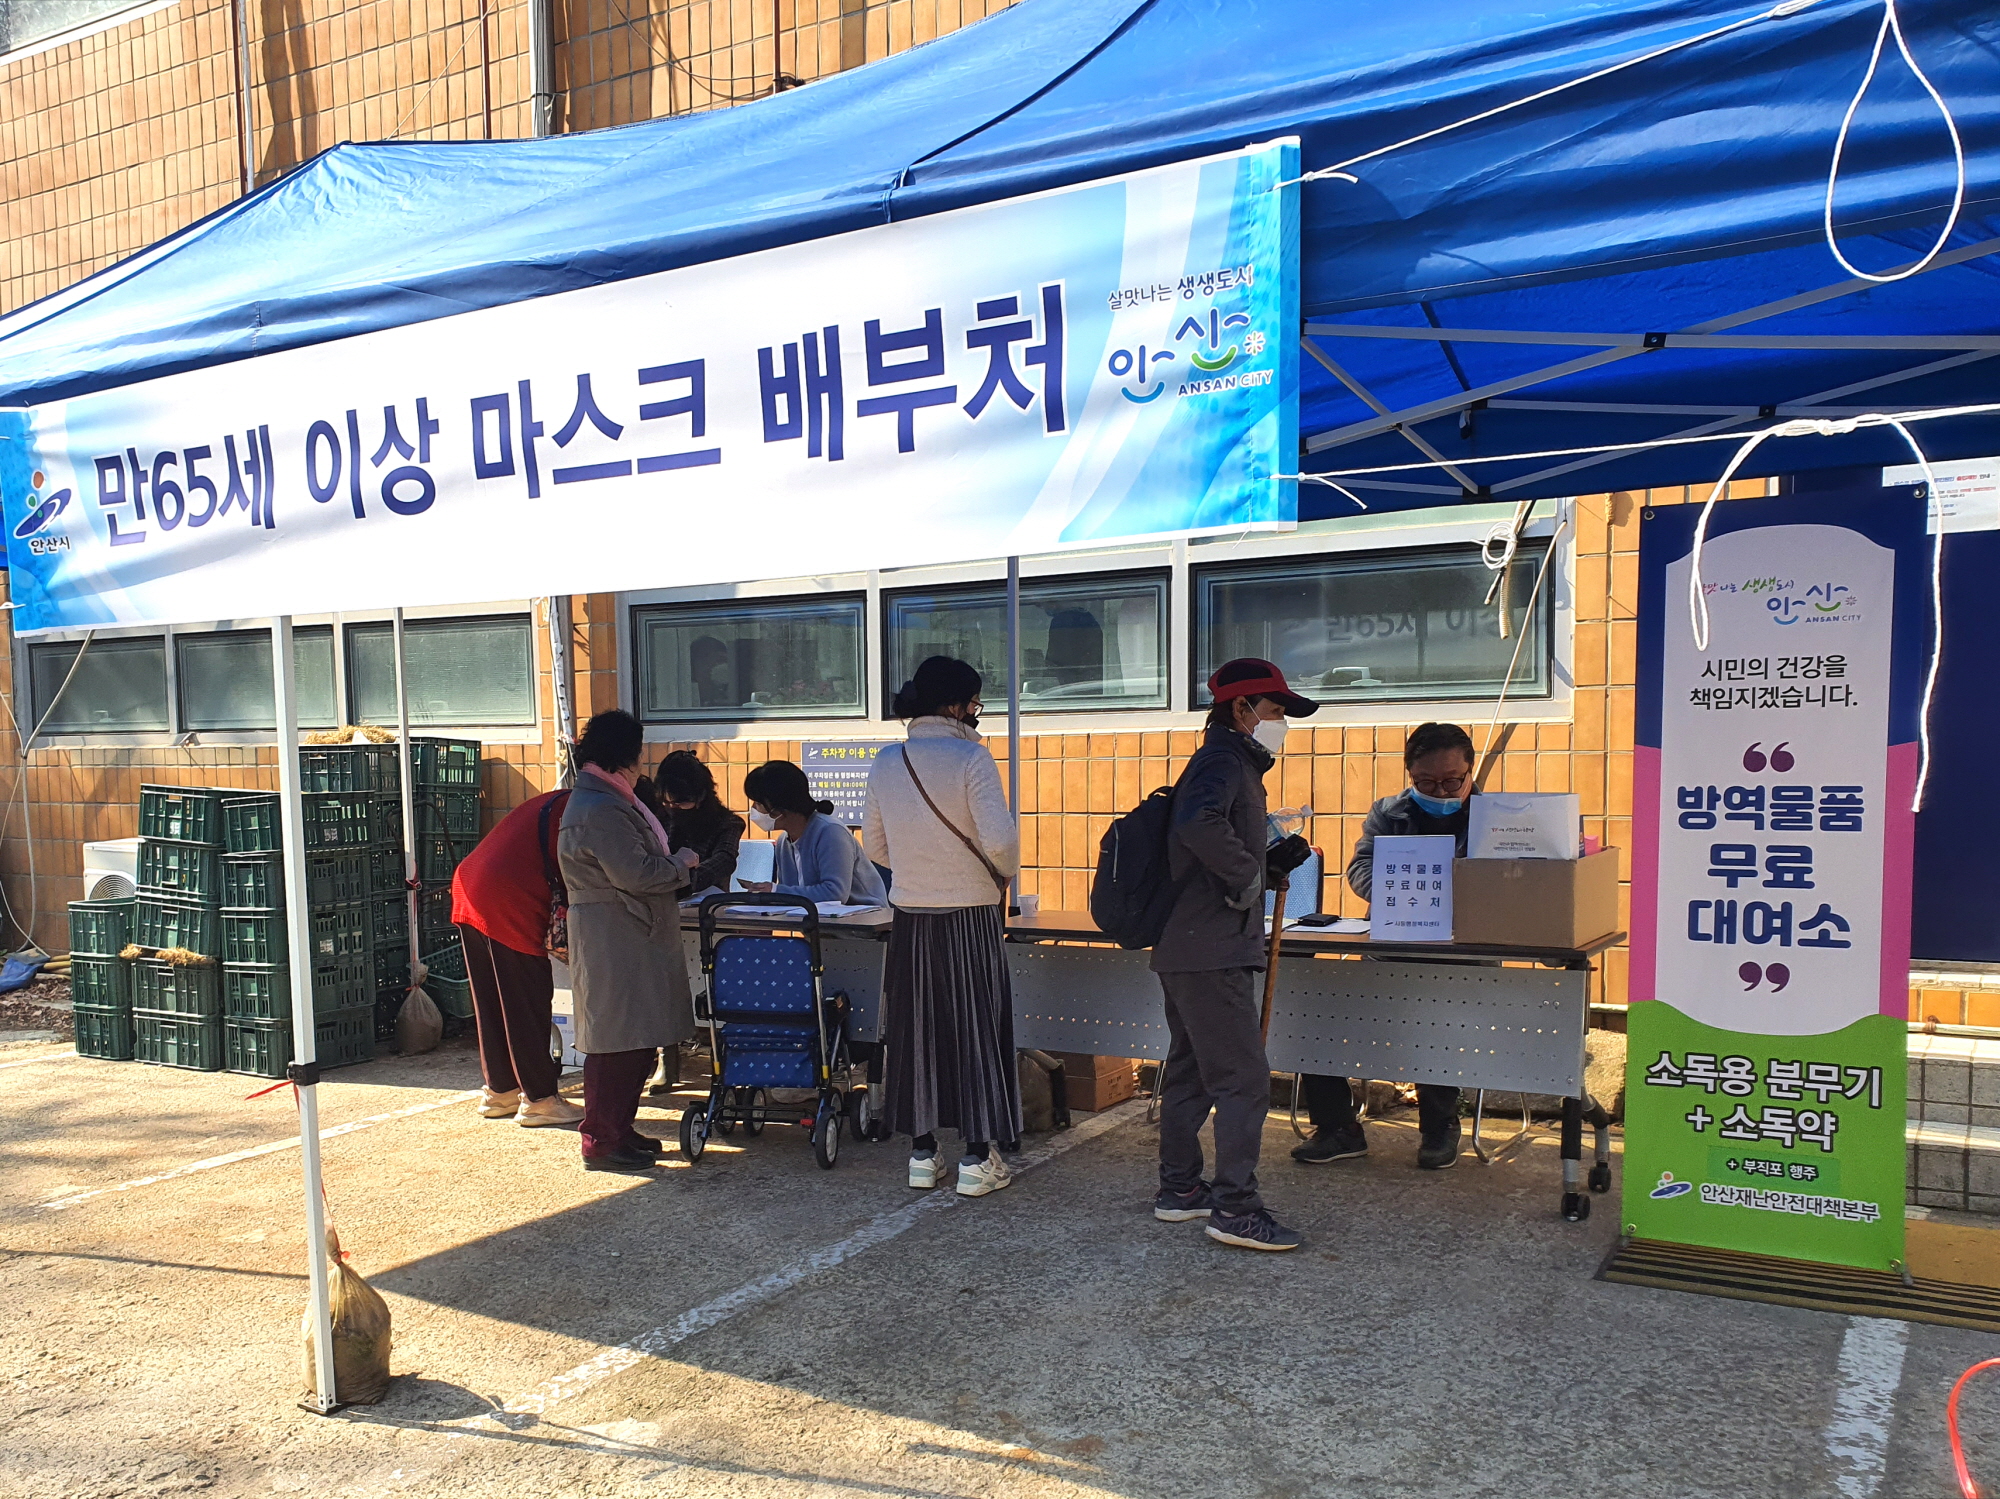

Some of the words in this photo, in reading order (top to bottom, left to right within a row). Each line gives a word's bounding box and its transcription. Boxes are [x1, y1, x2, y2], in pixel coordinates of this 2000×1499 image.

[1109, 284, 1172, 310] 살맛나는
[1177, 265, 1252, 299] 생생도시
[1109, 308, 1249, 404] 안산
[1178, 377, 1236, 396] ANSAN
[1240, 369, 1275, 386] CITY
[94, 424, 275, 547] 만65세
[306, 397, 439, 519] 이상
[471, 358, 721, 499] 마스크
[757, 283, 1066, 461] 배부처
[31, 536, 71, 554] 안산시
[1742, 577, 1795, 594] 생생도시
[1767, 582, 1849, 626] 안산
[1805, 615, 1840, 624] ANSAN
[1841, 614, 1862, 622] CITY
[1701, 657, 1769, 682] 시민의
[1776, 655, 1848, 679] 건강을
[1689, 684, 1858, 710] 책임지겠습니다.
[821, 747, 846, 759] 주차장
[848, 747, 866, 759] 이용
[869, 747, 880, 759] 안
[1677, 785, 1865, 832] 방역물품
[1707, 843, 1815, 889] 무료
[1688, 899, 1852, 949] 대여소
[1646, 1051, 1755, 1097] 소독용
[1766, 1058, 1883, 1108] 분무기
[1686, 1105, 1711, 1132] +
[1720, 1104, 1840, 1152] 소독약
[1727, 1159, 1737, 1169] +
[1743, 1158, 1783, 1177] 부직포
[1790, 1163, 1817, 1181] 행주
[1701, 1183, 1880, 1222] 안산재난안전대책본부
